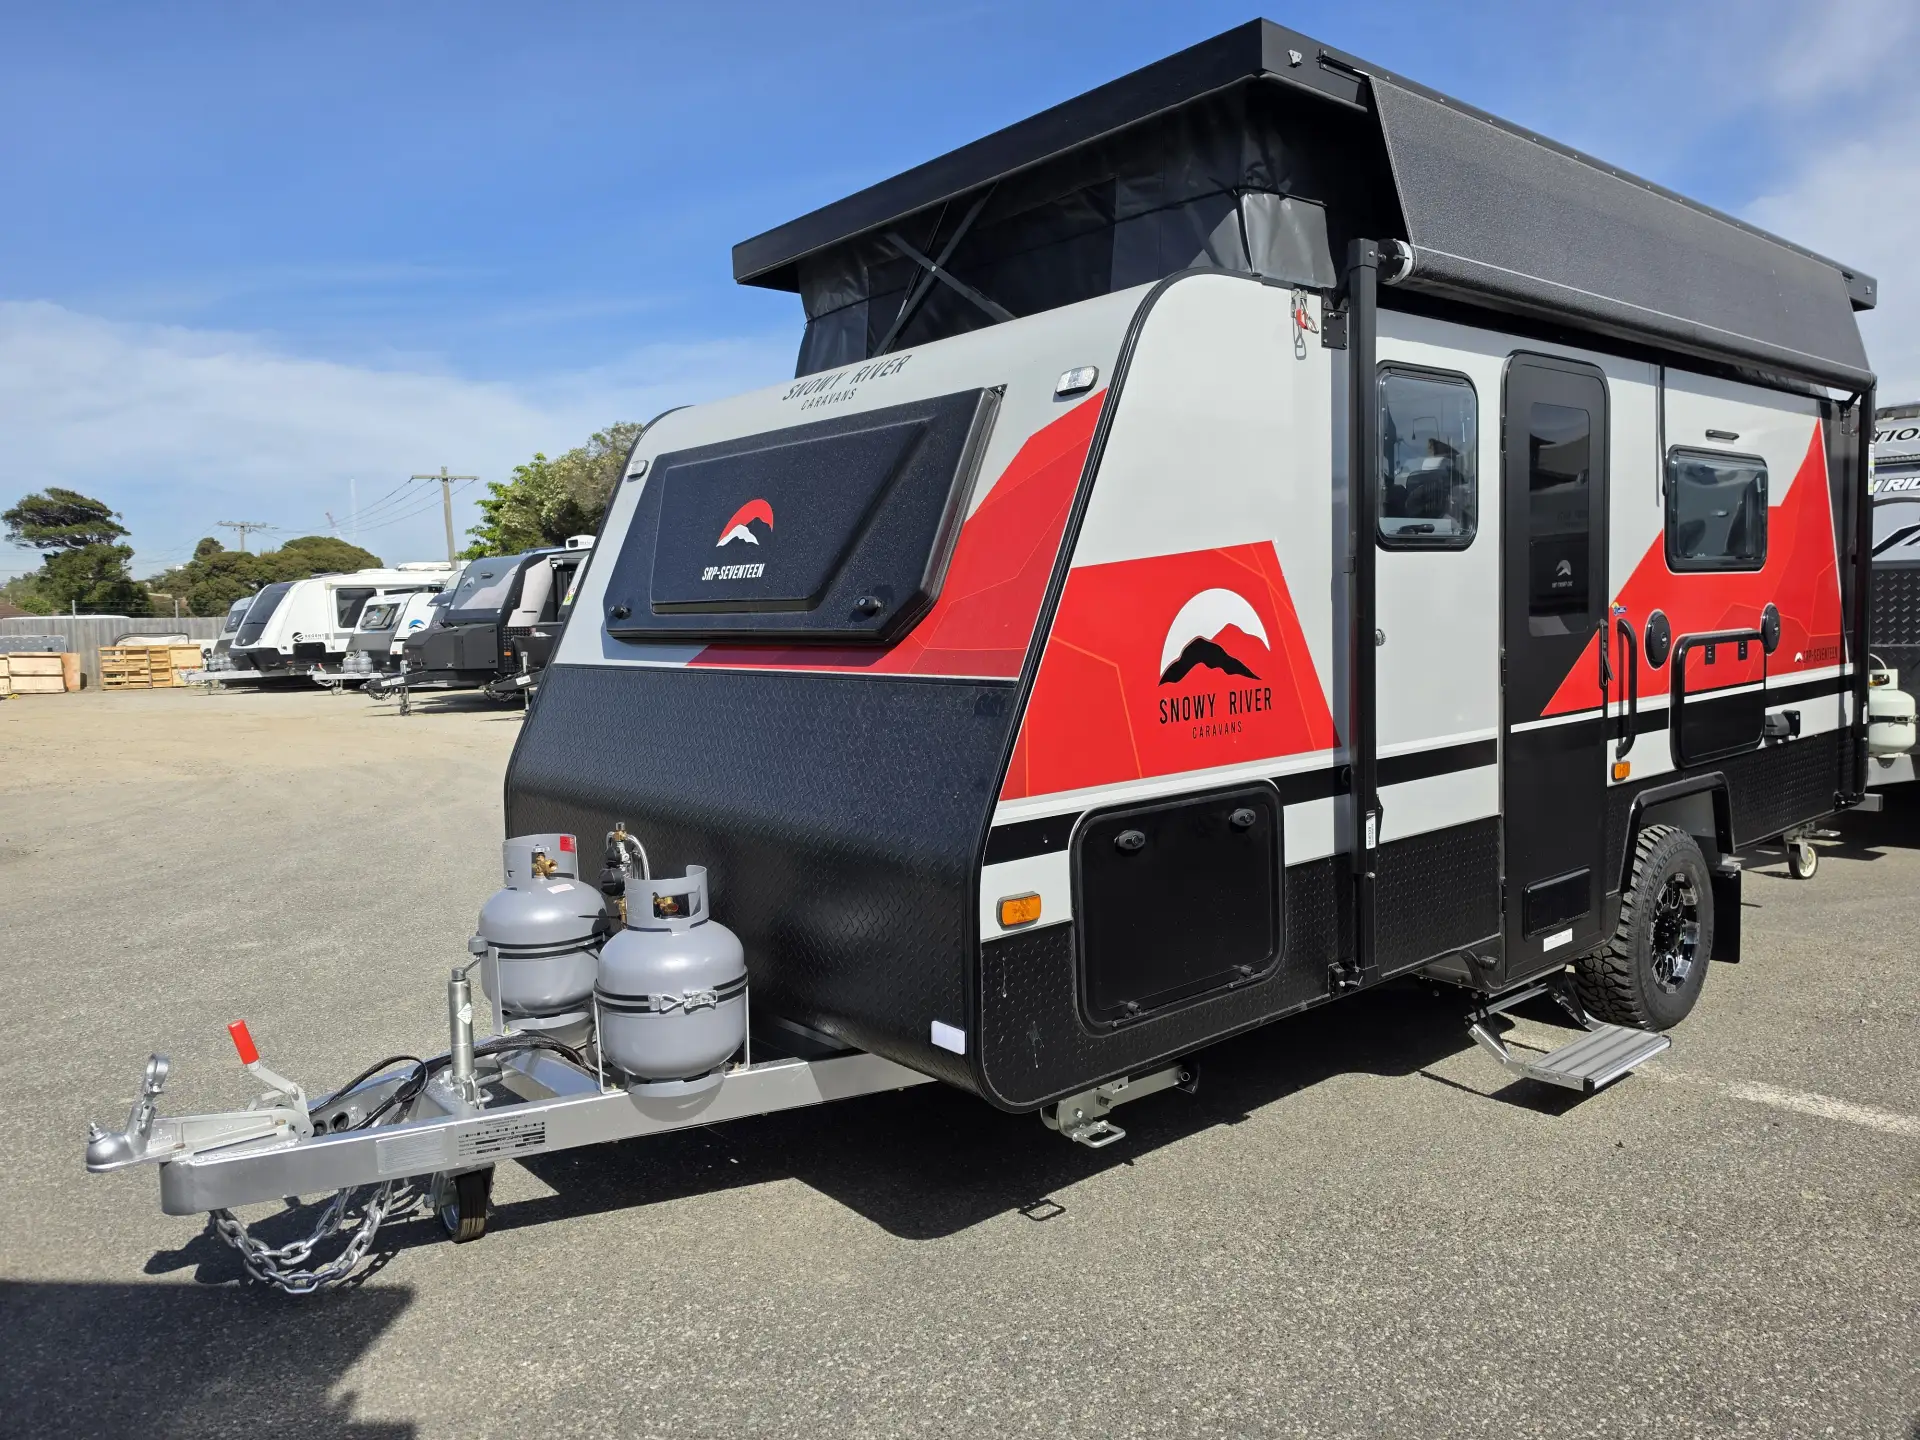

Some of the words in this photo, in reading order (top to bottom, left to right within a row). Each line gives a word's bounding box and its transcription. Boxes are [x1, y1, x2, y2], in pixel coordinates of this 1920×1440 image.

[782, 371, 850, 401] SNOWY
[849, 354, 913, 385] RIVER
[801, 388, 857, 411] CARAVANS
[701, 563, 765, 581] SRP-SEVENTEEN
[1159, 693, 1216, 724] SNOWY
[1229, 687, 1272, 715] RIVER
[1192, 721, 1243, 739] CARAVANS
